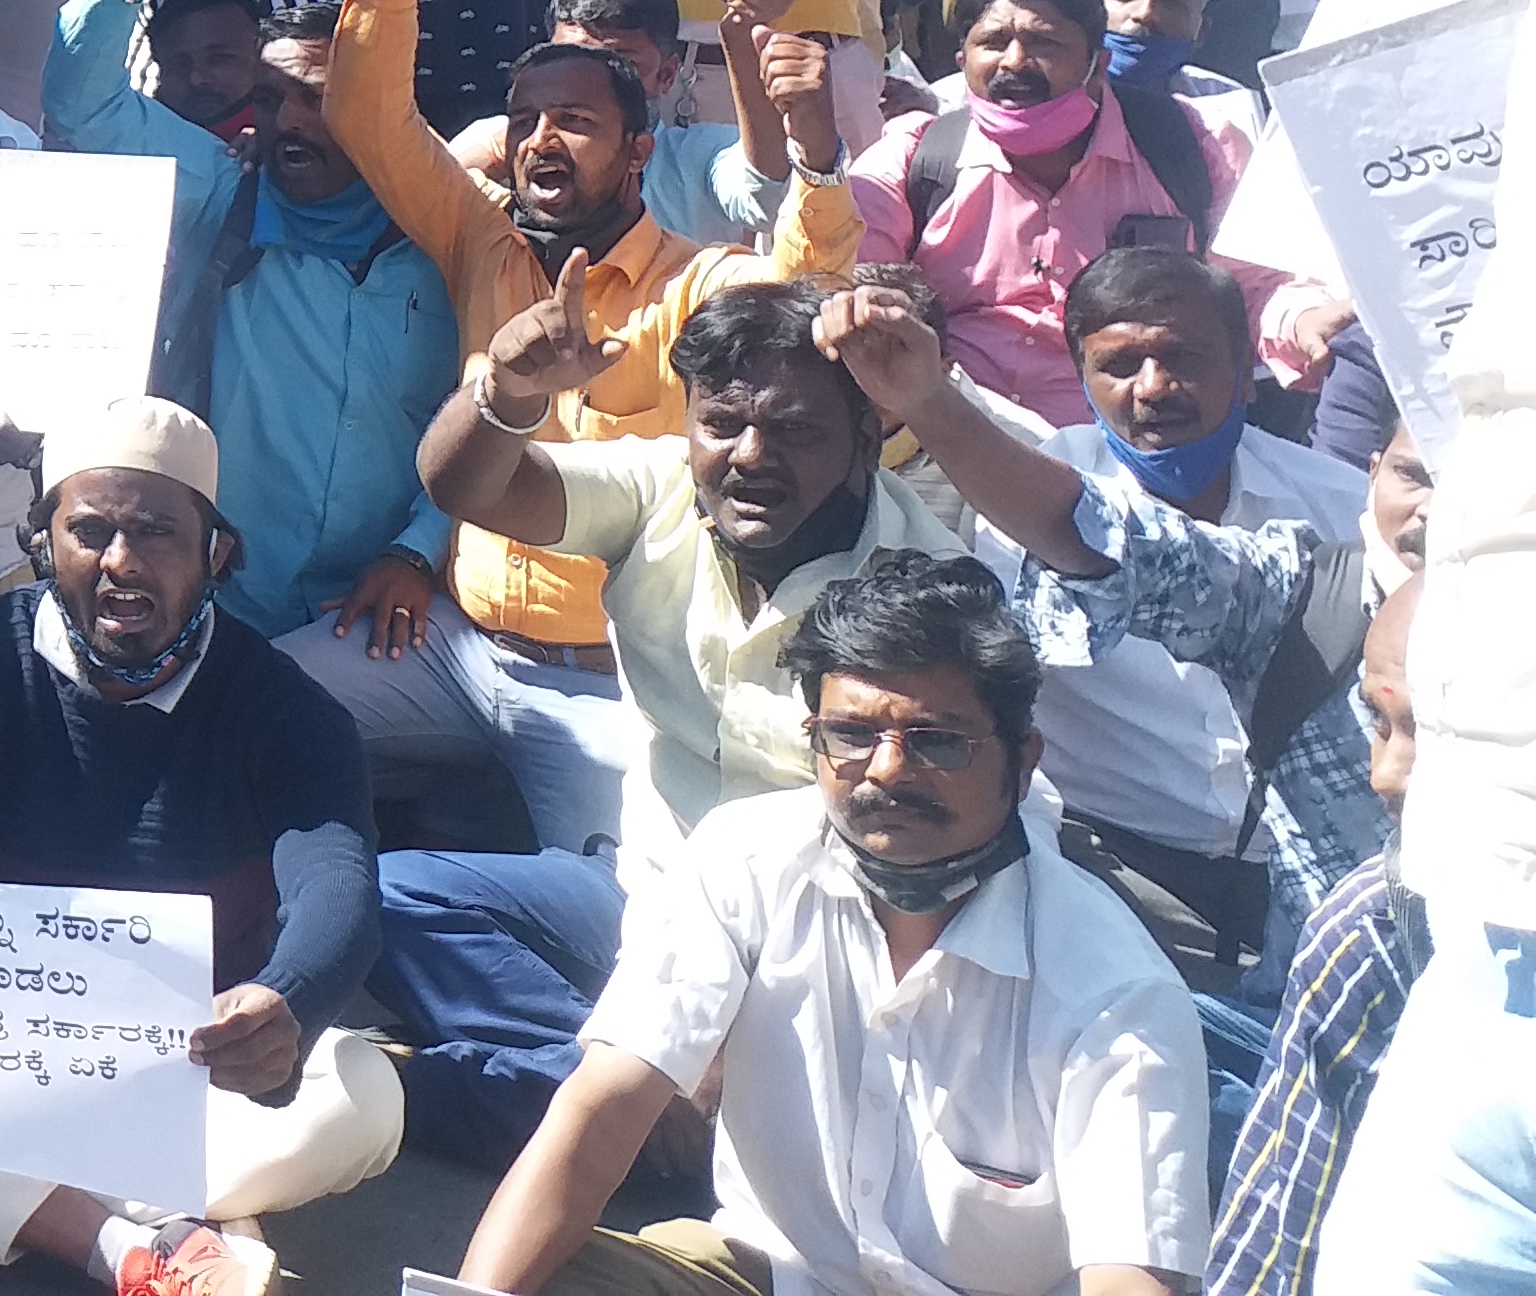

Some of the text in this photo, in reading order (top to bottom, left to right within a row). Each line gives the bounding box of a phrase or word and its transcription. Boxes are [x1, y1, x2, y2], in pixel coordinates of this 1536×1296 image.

[35, 907, 153, 945] ಸರ್ಕಾರಿ
[26, 1012, 187, 1058] ಸರ್ಕಾರಕ್ಕೆ!!
[68, 1054, 119, 1081] ಏಕೆ
